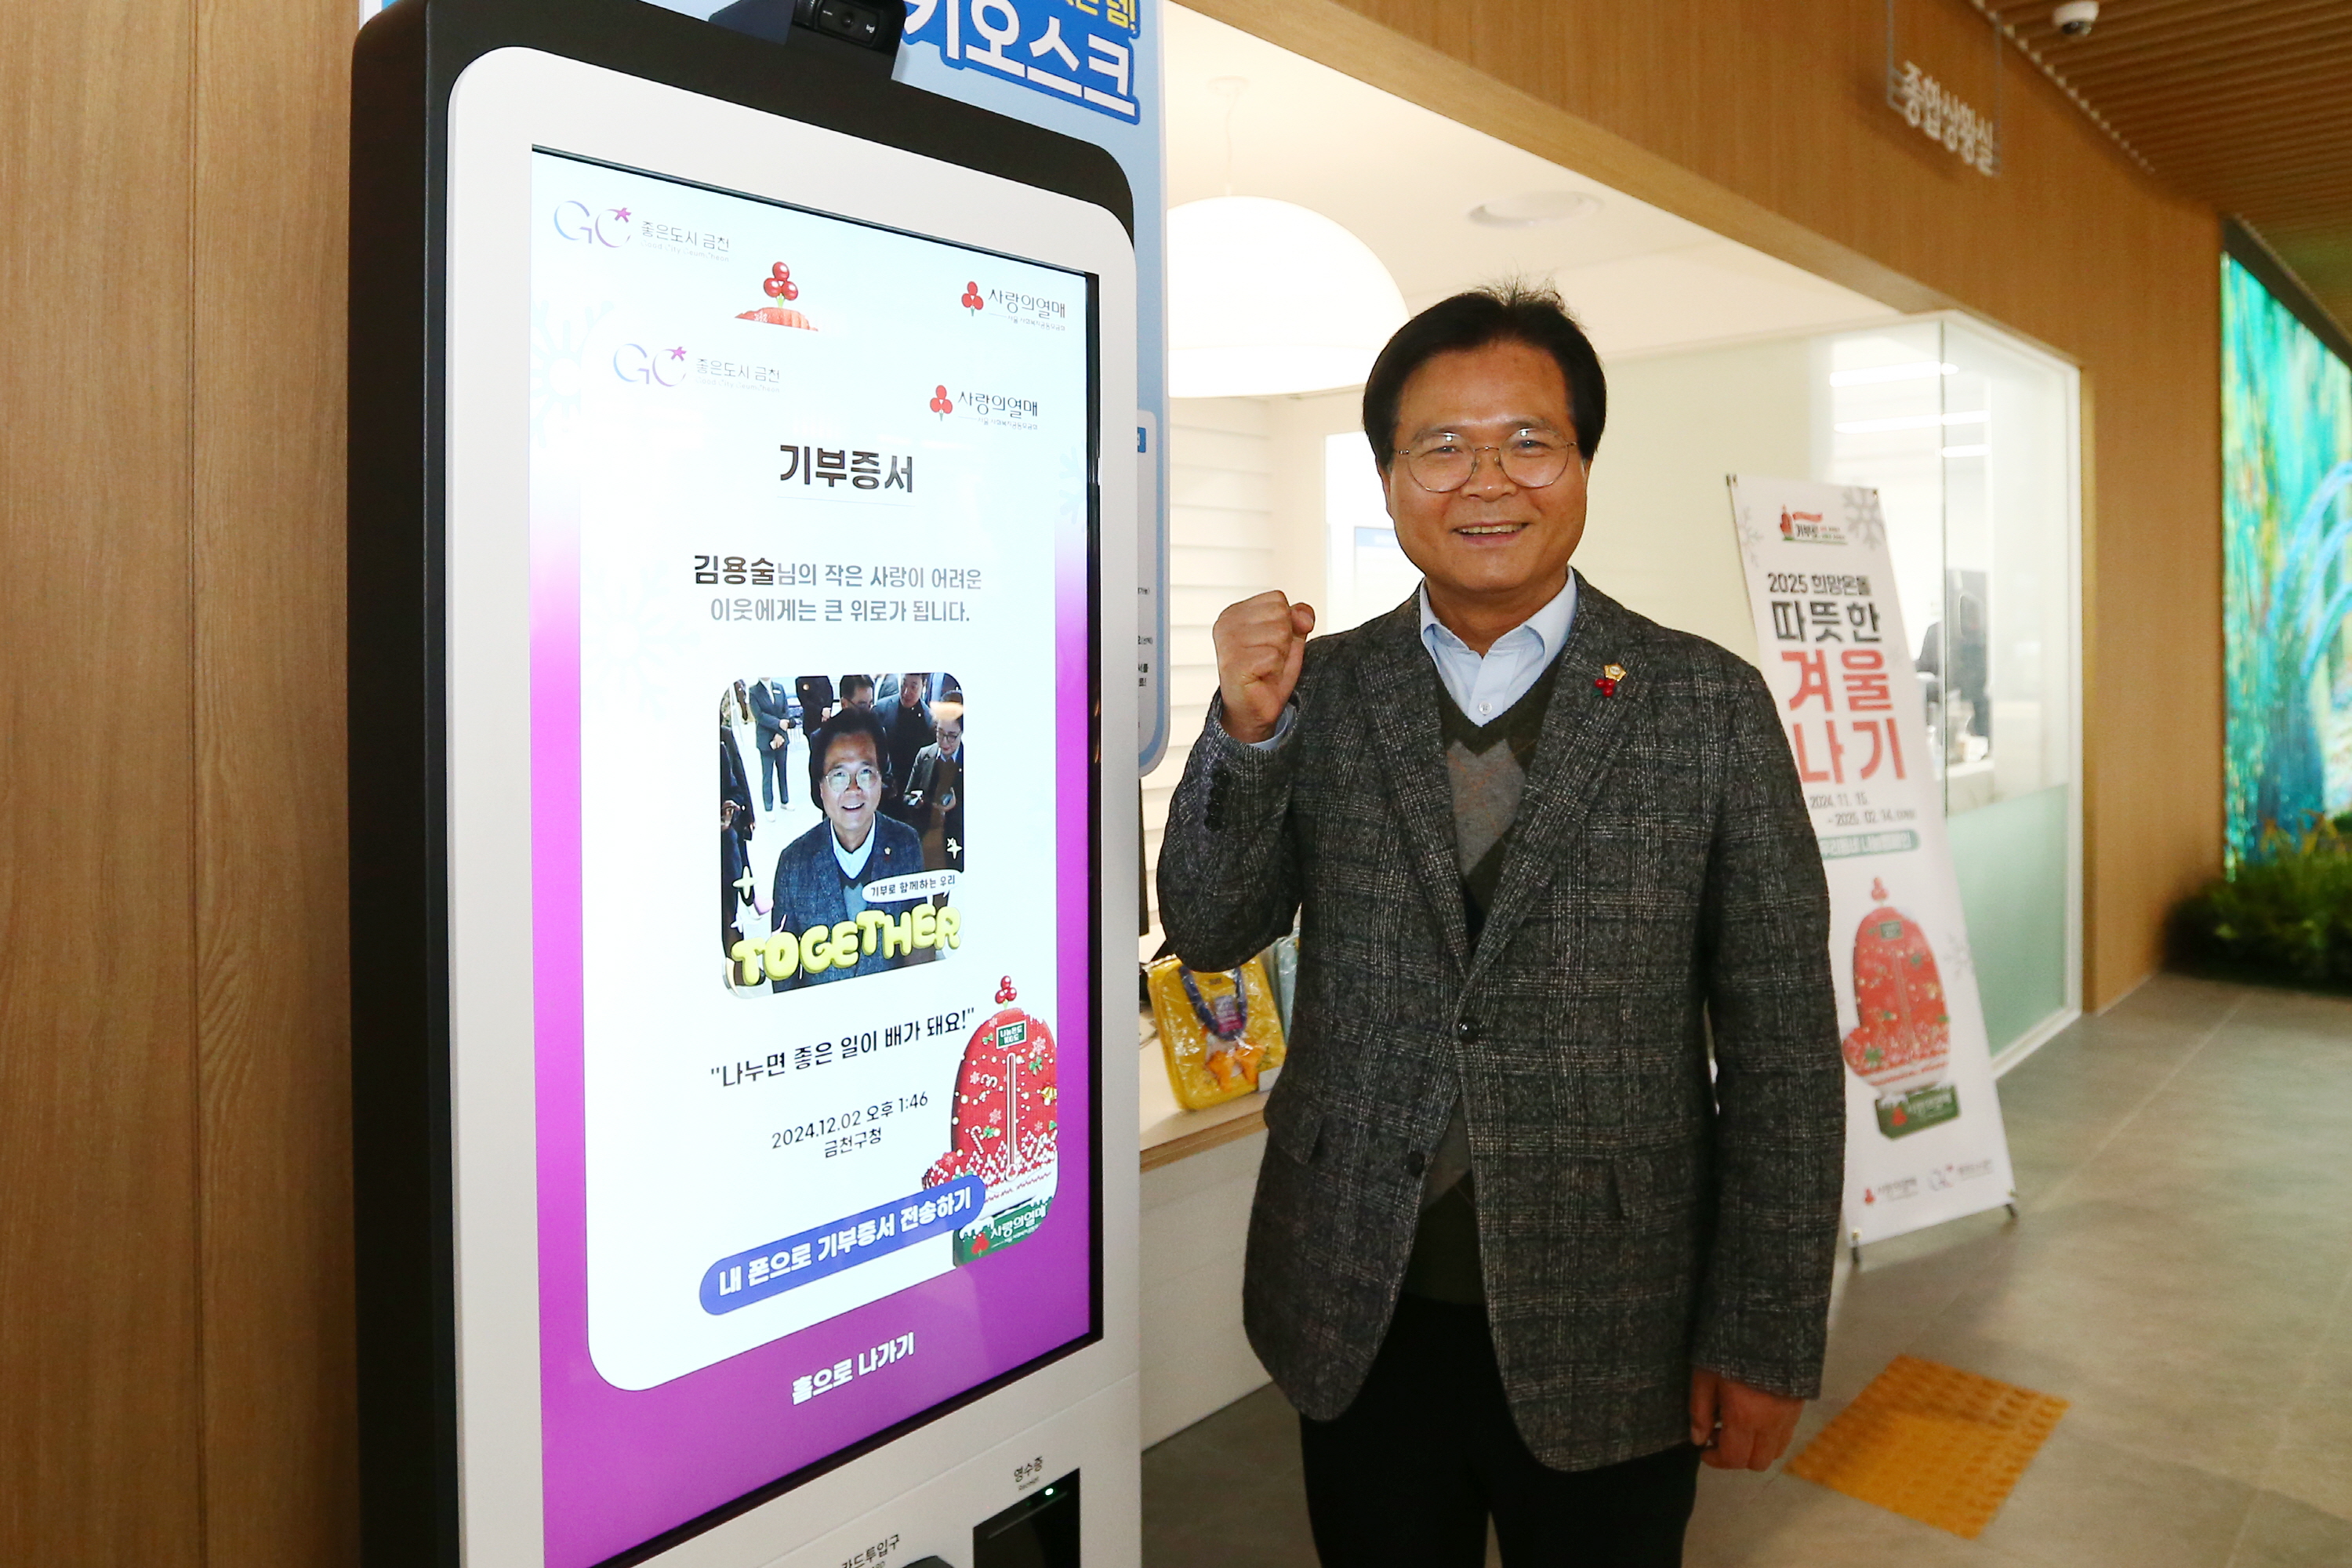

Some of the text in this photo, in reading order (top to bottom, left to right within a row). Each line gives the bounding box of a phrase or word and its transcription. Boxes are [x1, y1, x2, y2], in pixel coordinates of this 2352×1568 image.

[1901, 59, 1994, 178] 종합상황실
[641, 220, 730, 252] 좋은도시 금천
[988, 289, 1065, 320] 사랑의열매
[695, 358, 780, 383] 좋은도시 금천
[957, 390, 1038, 419] 사랑의열매
[780, 444, 913, 493] 기부증서
[694, 554, 982, 590] 김용술님의 작은 사랑이 어려운
[1768, 572, 1808, 593] 2025
[710, 597, 970, 622] 이웃에게는 큰 위로가 됩니다.
[1771, 601, 1883, 643] 따뜻한
[1780, 648, 1894, 713] 겨울
[1792, 717, 1907, 785] 나기
[871, 874, 956, 897] 기부로 함께하는 우리
[731, 903, 961, 986] TOGETHER
[710, 1007, 975, 1087] "나누면 좋은 일이 배가 돼요!"
[771, 1091, 928, 1149] 2024.12.02 오후 1:46
[824, 1127, 882, 1159] 금천구청
[990, 1203, 1047, 1240] 사랑의열매
[718, 1186, 971, 1297] 내 폰으로 기부증서 전송하기
[792, 1330, 915, 1406] 홈으로 나가기
[1014, 1456, 1043, 1483] 영수증
